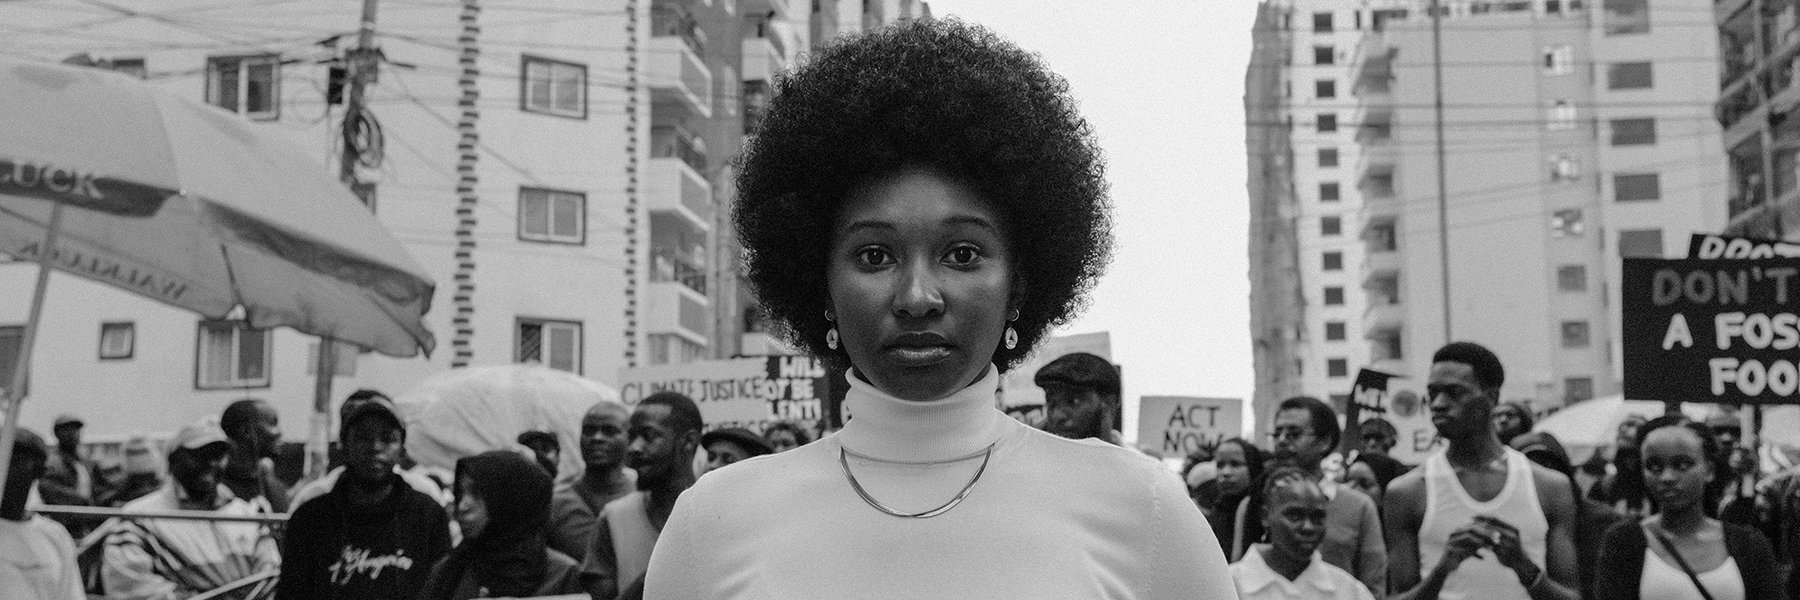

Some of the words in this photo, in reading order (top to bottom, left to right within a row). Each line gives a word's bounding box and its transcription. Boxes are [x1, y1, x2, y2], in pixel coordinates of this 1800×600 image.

[1652, 267, 1799, 305] DON'T
[1662, 313, 1694, 351] A
[1714, 311, 1800, 351] FOS
[701, 376, 764, 402] JUSTICE
[763, 379, 791, 401] OT
[791, 378, 814, 400] BE
[1708, 357, 1800, 397] FOO
[1168, 403, 1221, 429] ACT
[1163, 431, 1224, 456] NOW
